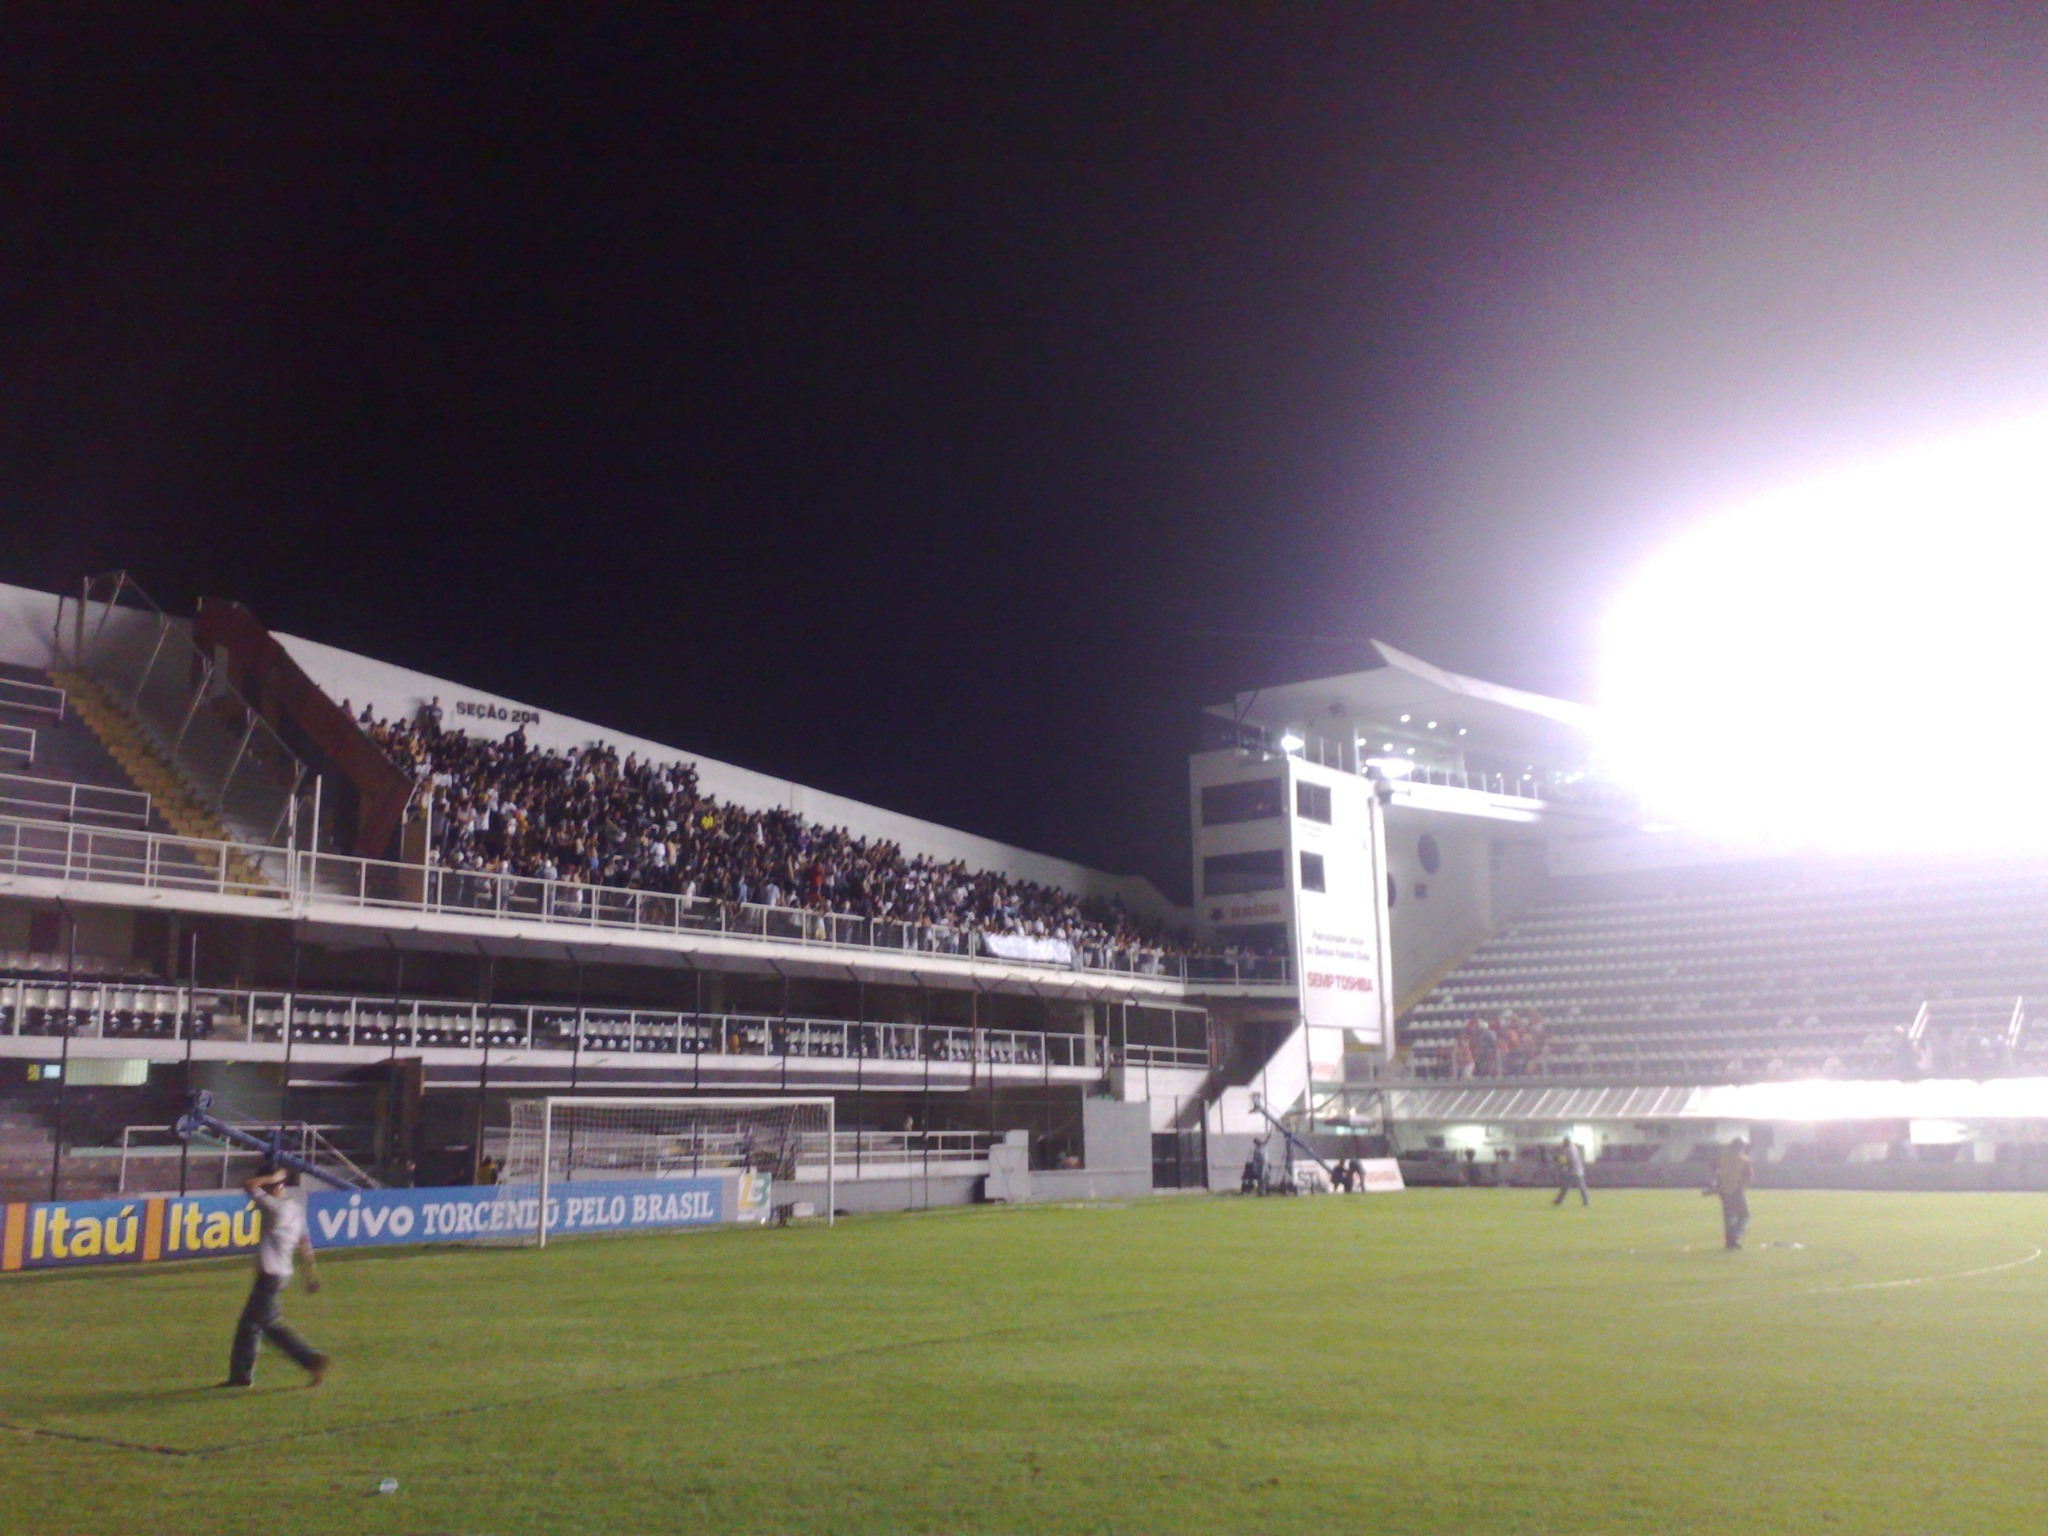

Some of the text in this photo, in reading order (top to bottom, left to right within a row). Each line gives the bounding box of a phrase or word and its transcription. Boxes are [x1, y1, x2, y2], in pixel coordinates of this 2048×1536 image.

[456, 701, 508, 720] SEÇÃO
[1335, 974, 1373, 992] TOSHIBA
[30, 1204, 139, 1260] Itaú
[168, 1199, 262, 1252] Itaú
[317, 1193, 415, 1240] vivo
[422, 1191, 714, 1236] TORCENDO PELO BRASIL
